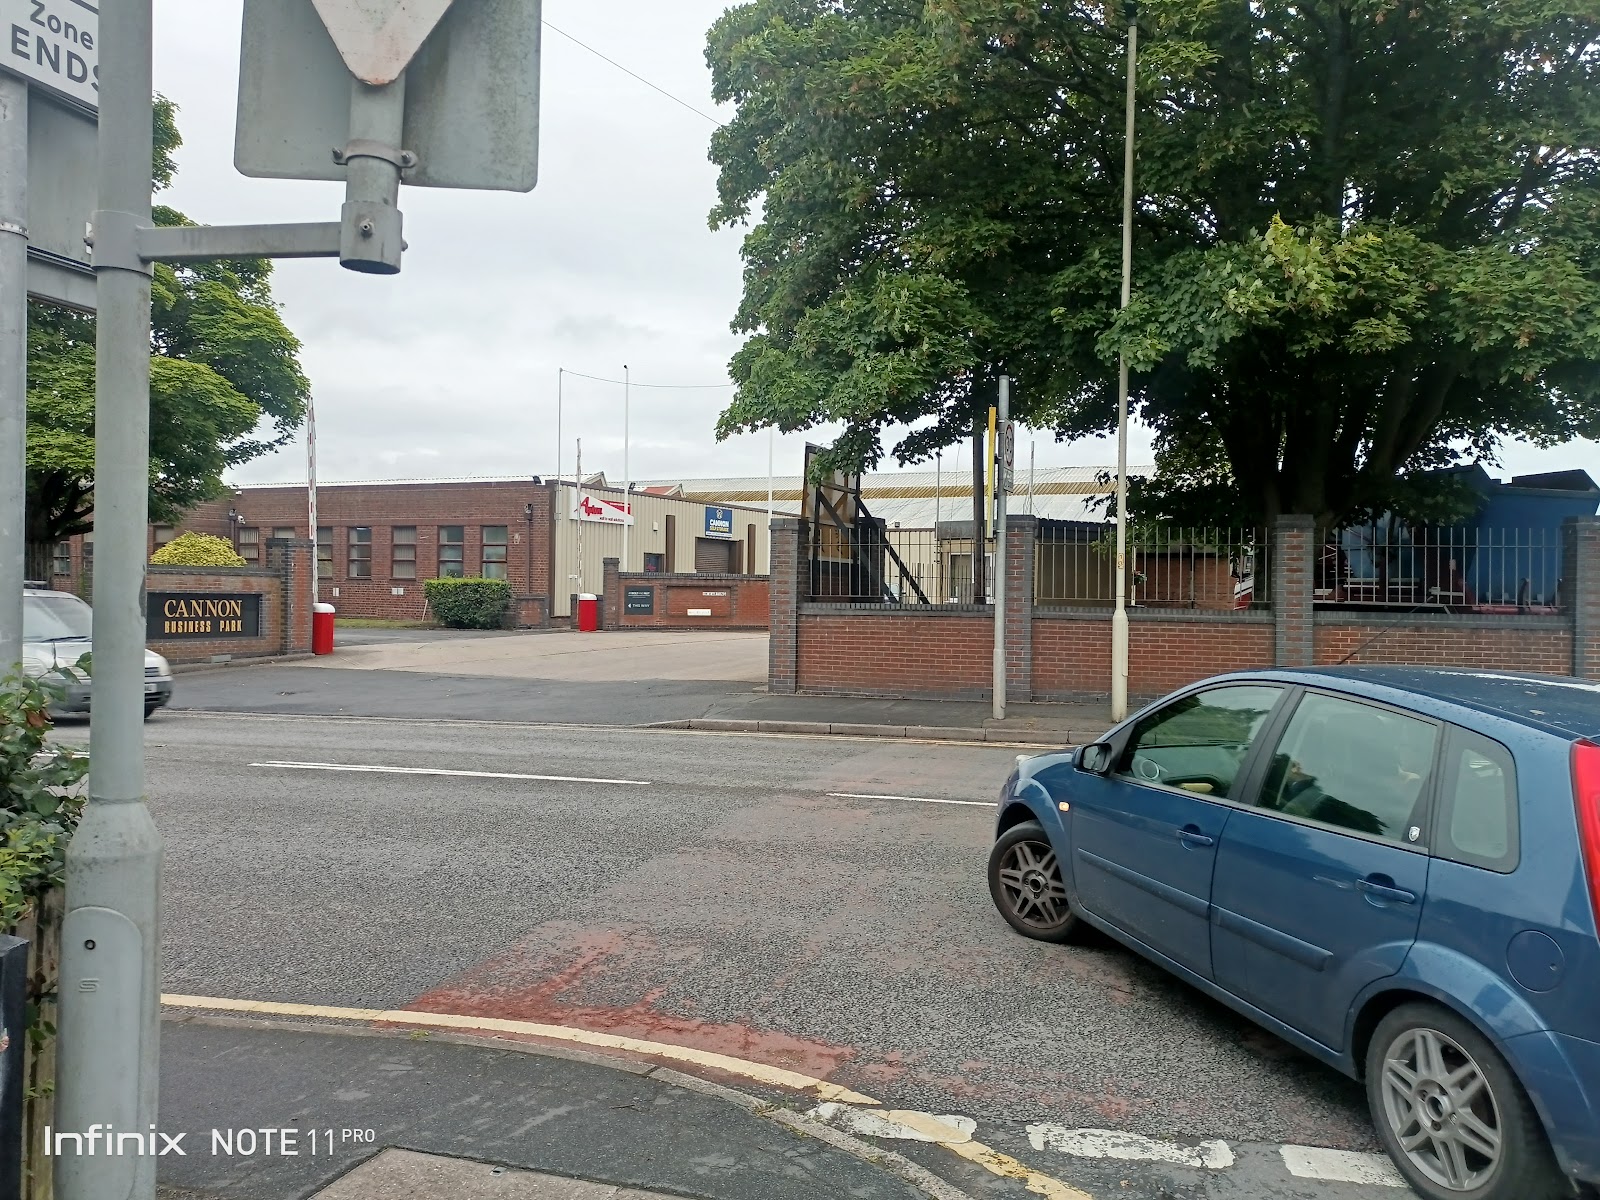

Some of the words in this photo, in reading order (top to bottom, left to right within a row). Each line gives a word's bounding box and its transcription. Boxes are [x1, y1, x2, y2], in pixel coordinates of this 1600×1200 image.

[30, 0, 94, 51] Zone
[164, 599, 242, 618] CANNON
[164, 620, 211, 634] BUSINESS
[219, 620, 242, 632] PARK
